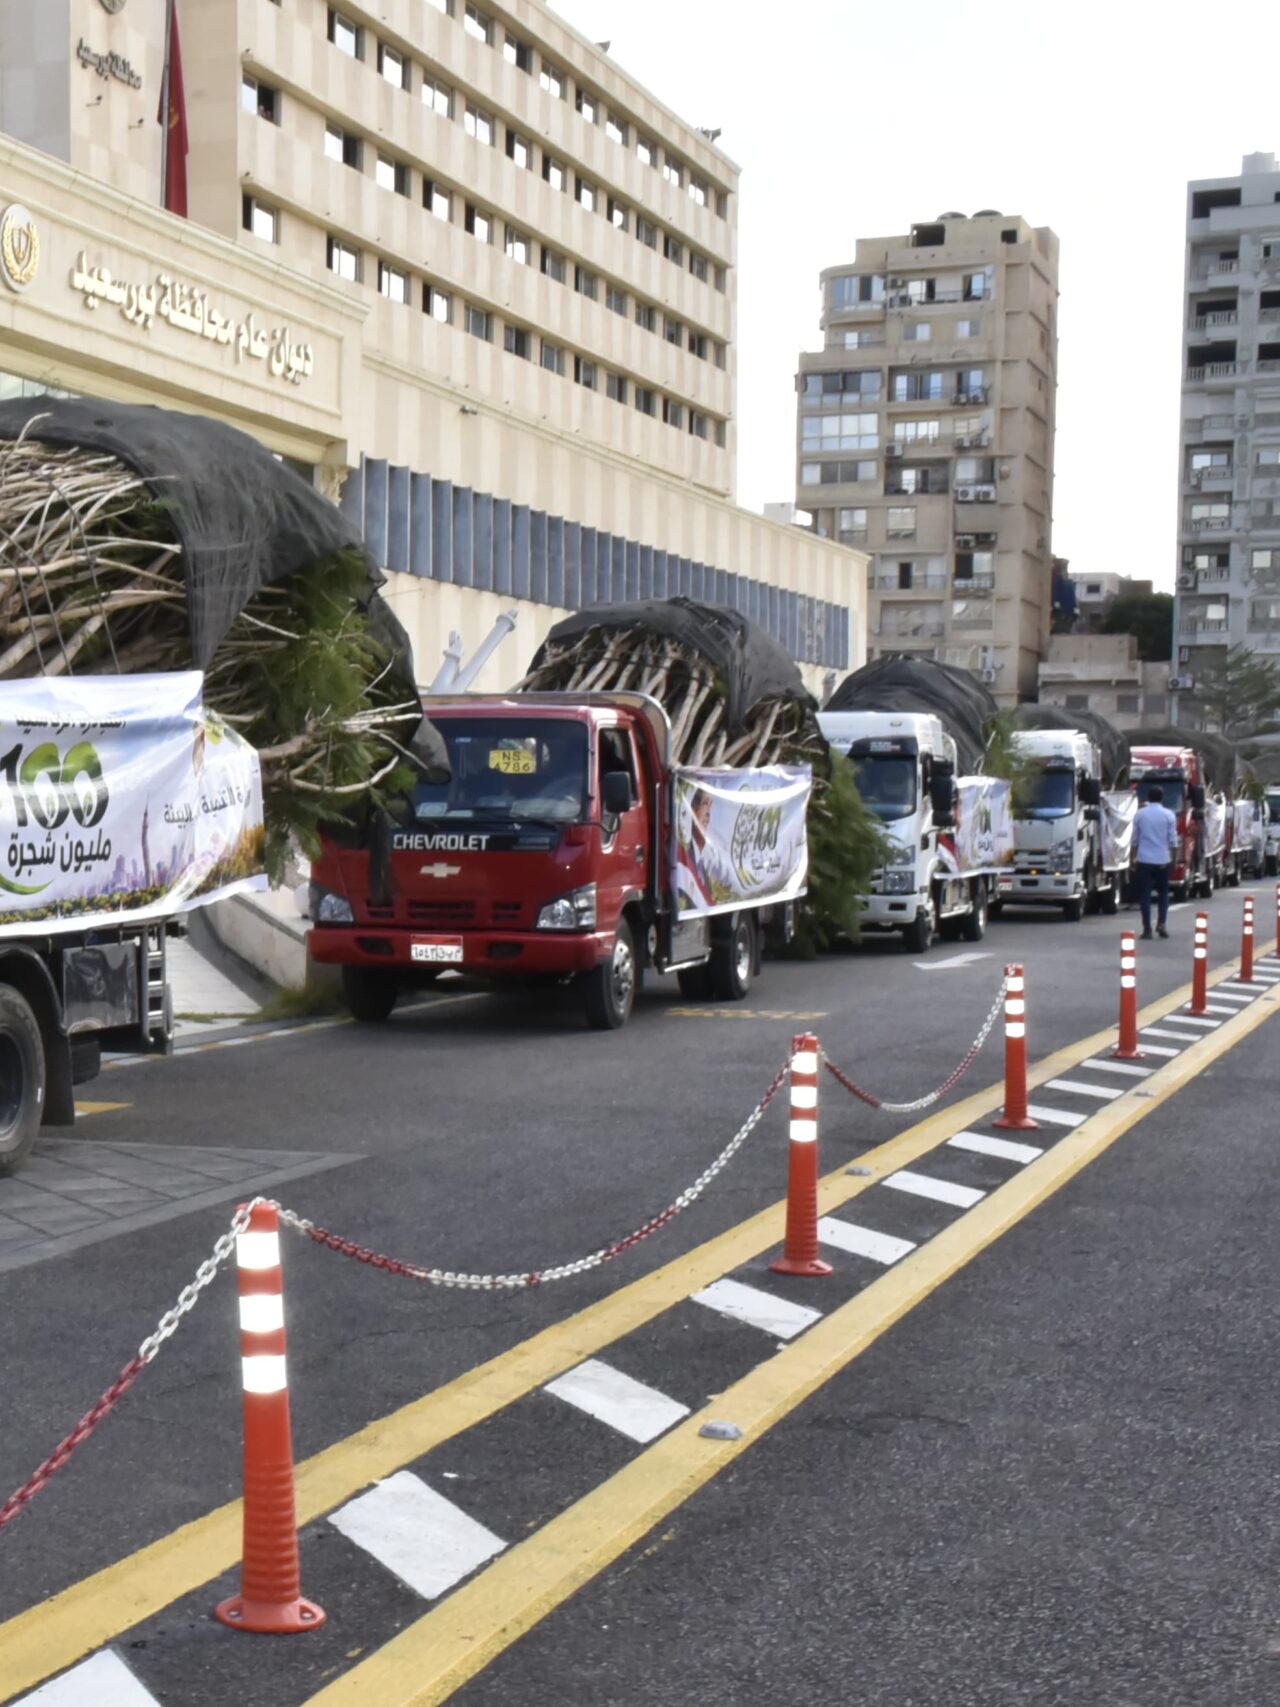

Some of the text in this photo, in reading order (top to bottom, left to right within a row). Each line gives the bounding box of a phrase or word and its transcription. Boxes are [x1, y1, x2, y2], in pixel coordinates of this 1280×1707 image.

[70, 250, 313, 386] ديوان عام محافظة بورسعيد
[502, 751, 521, 761] NS
[0, 741, 109, 830] 100
[7, 829, 112, 877] مليون شجرة
[393, 833, 490, 850] CHEVROLET
